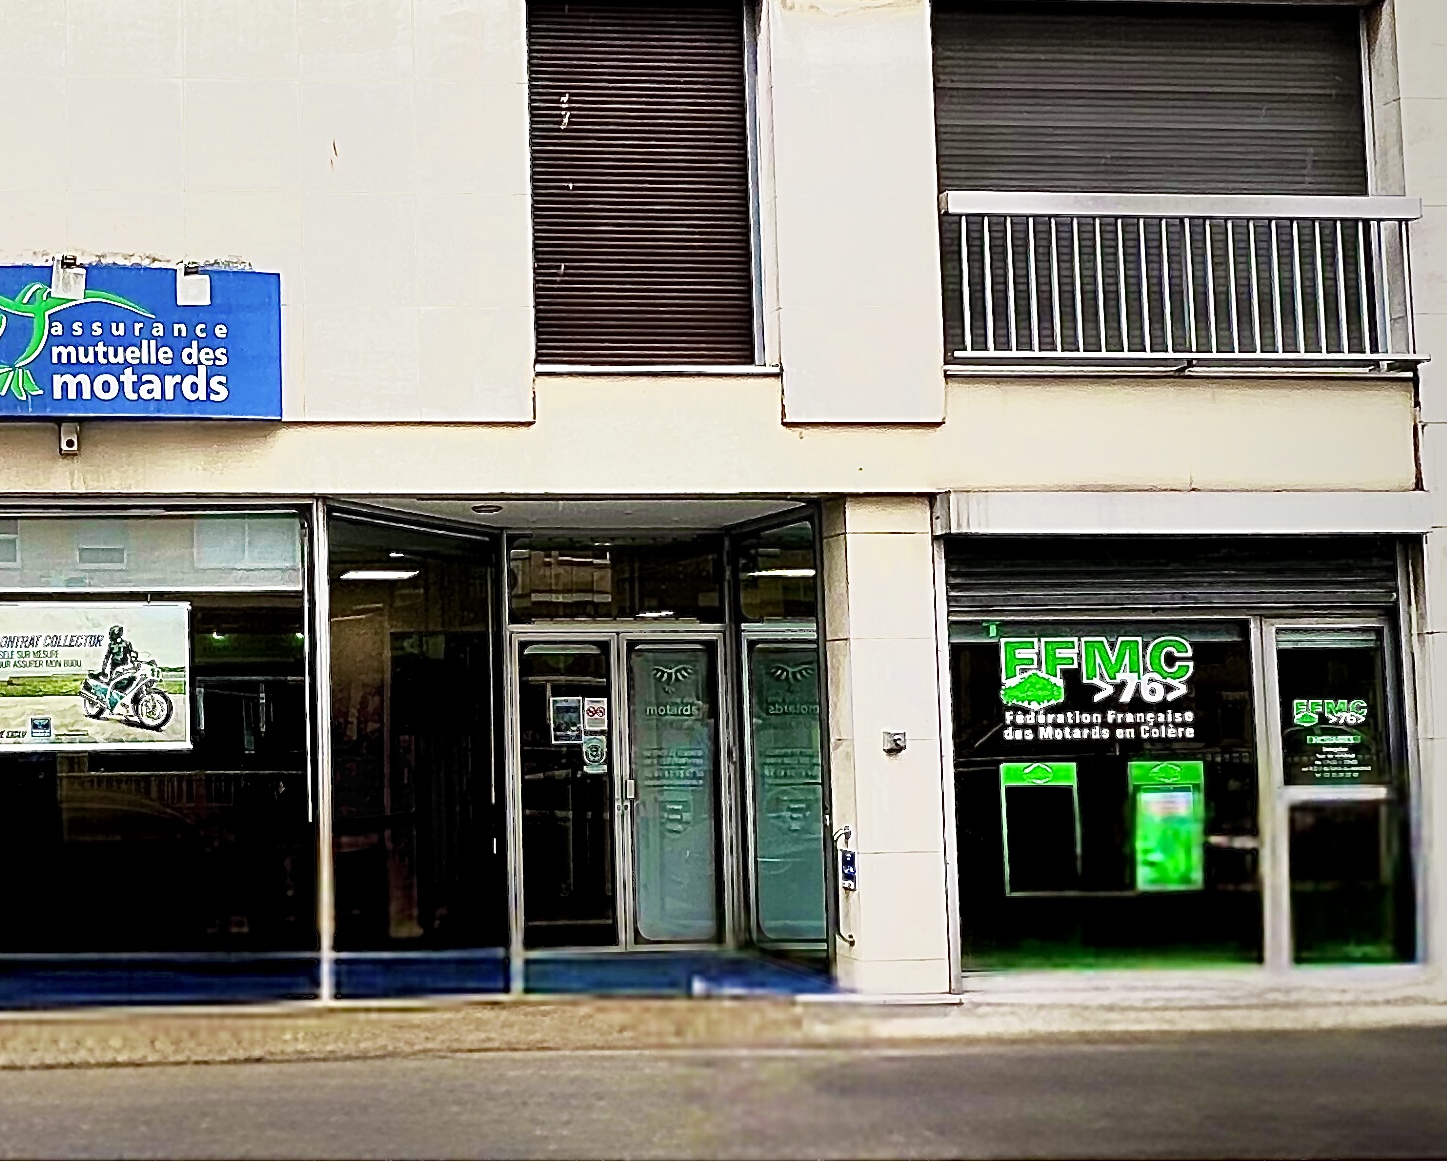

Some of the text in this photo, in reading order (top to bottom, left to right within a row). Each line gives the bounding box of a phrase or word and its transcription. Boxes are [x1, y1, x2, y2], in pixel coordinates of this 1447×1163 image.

[50, 322, 229, 338] assurance
[51, 340, 229, 366] mutuelle des
[51, 365, 230, 401] motards
[43, 634, 105, 648] COLLECTOR
[1000, 636, 1195, 684] FFMC
[645, 704, 700, 715] motards
[1293, 699, 1368, 717] FFMC
[1004, 710, 1195, 726] Fédération Française
[1003, 725, 1195, 740] des Motards en Colère
